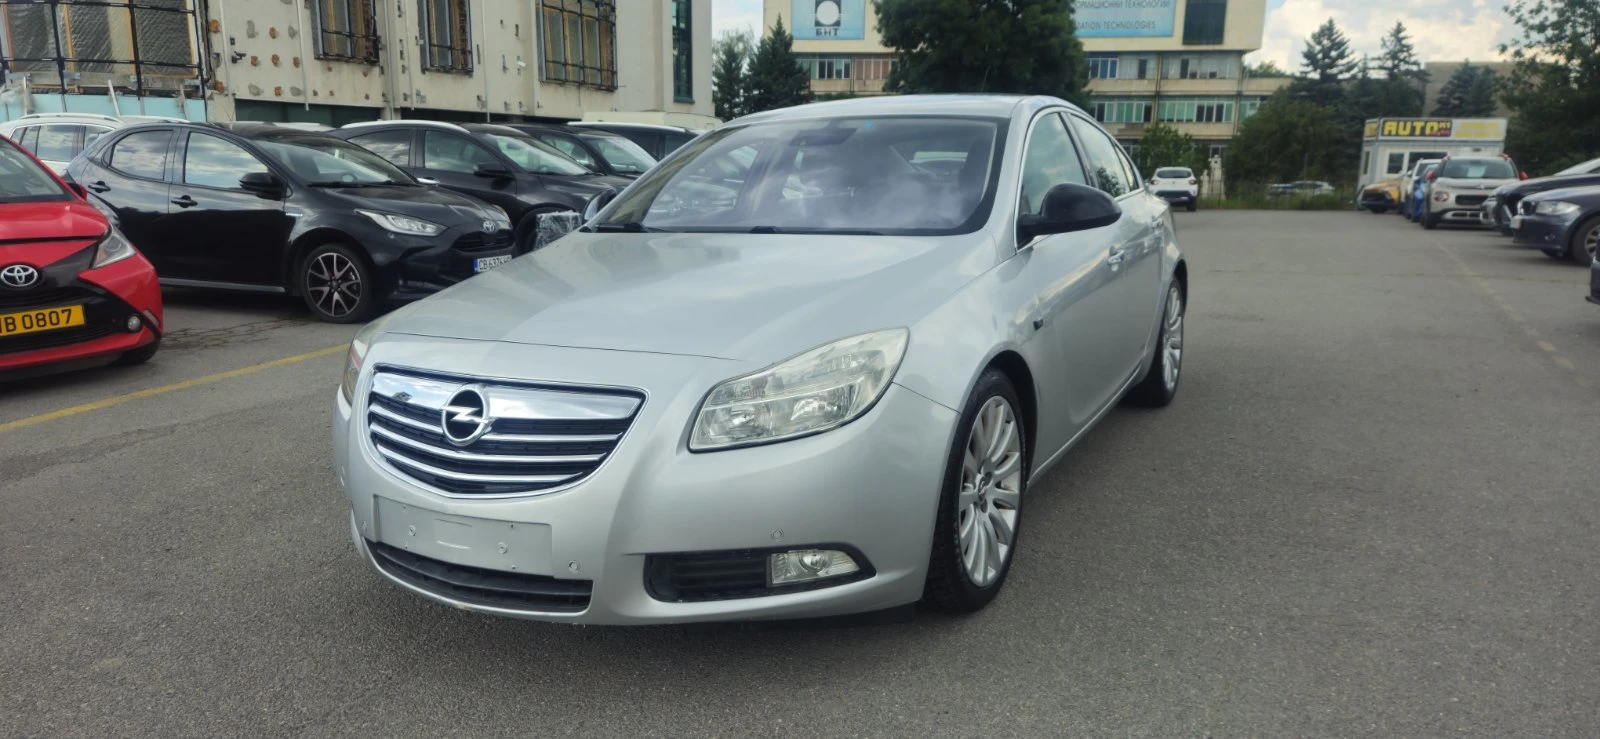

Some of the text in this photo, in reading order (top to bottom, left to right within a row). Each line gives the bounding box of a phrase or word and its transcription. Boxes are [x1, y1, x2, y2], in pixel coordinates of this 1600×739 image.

[1072, 0, 1169, 9] ОРМАЦИОННИ ТЕХНОЛОГИИ
[1104, 20, 1157, 30] TECHNOLOGIES
[1383, 120, 1438, 136] AUTO
[0, 308, 72, 333] B 0807
